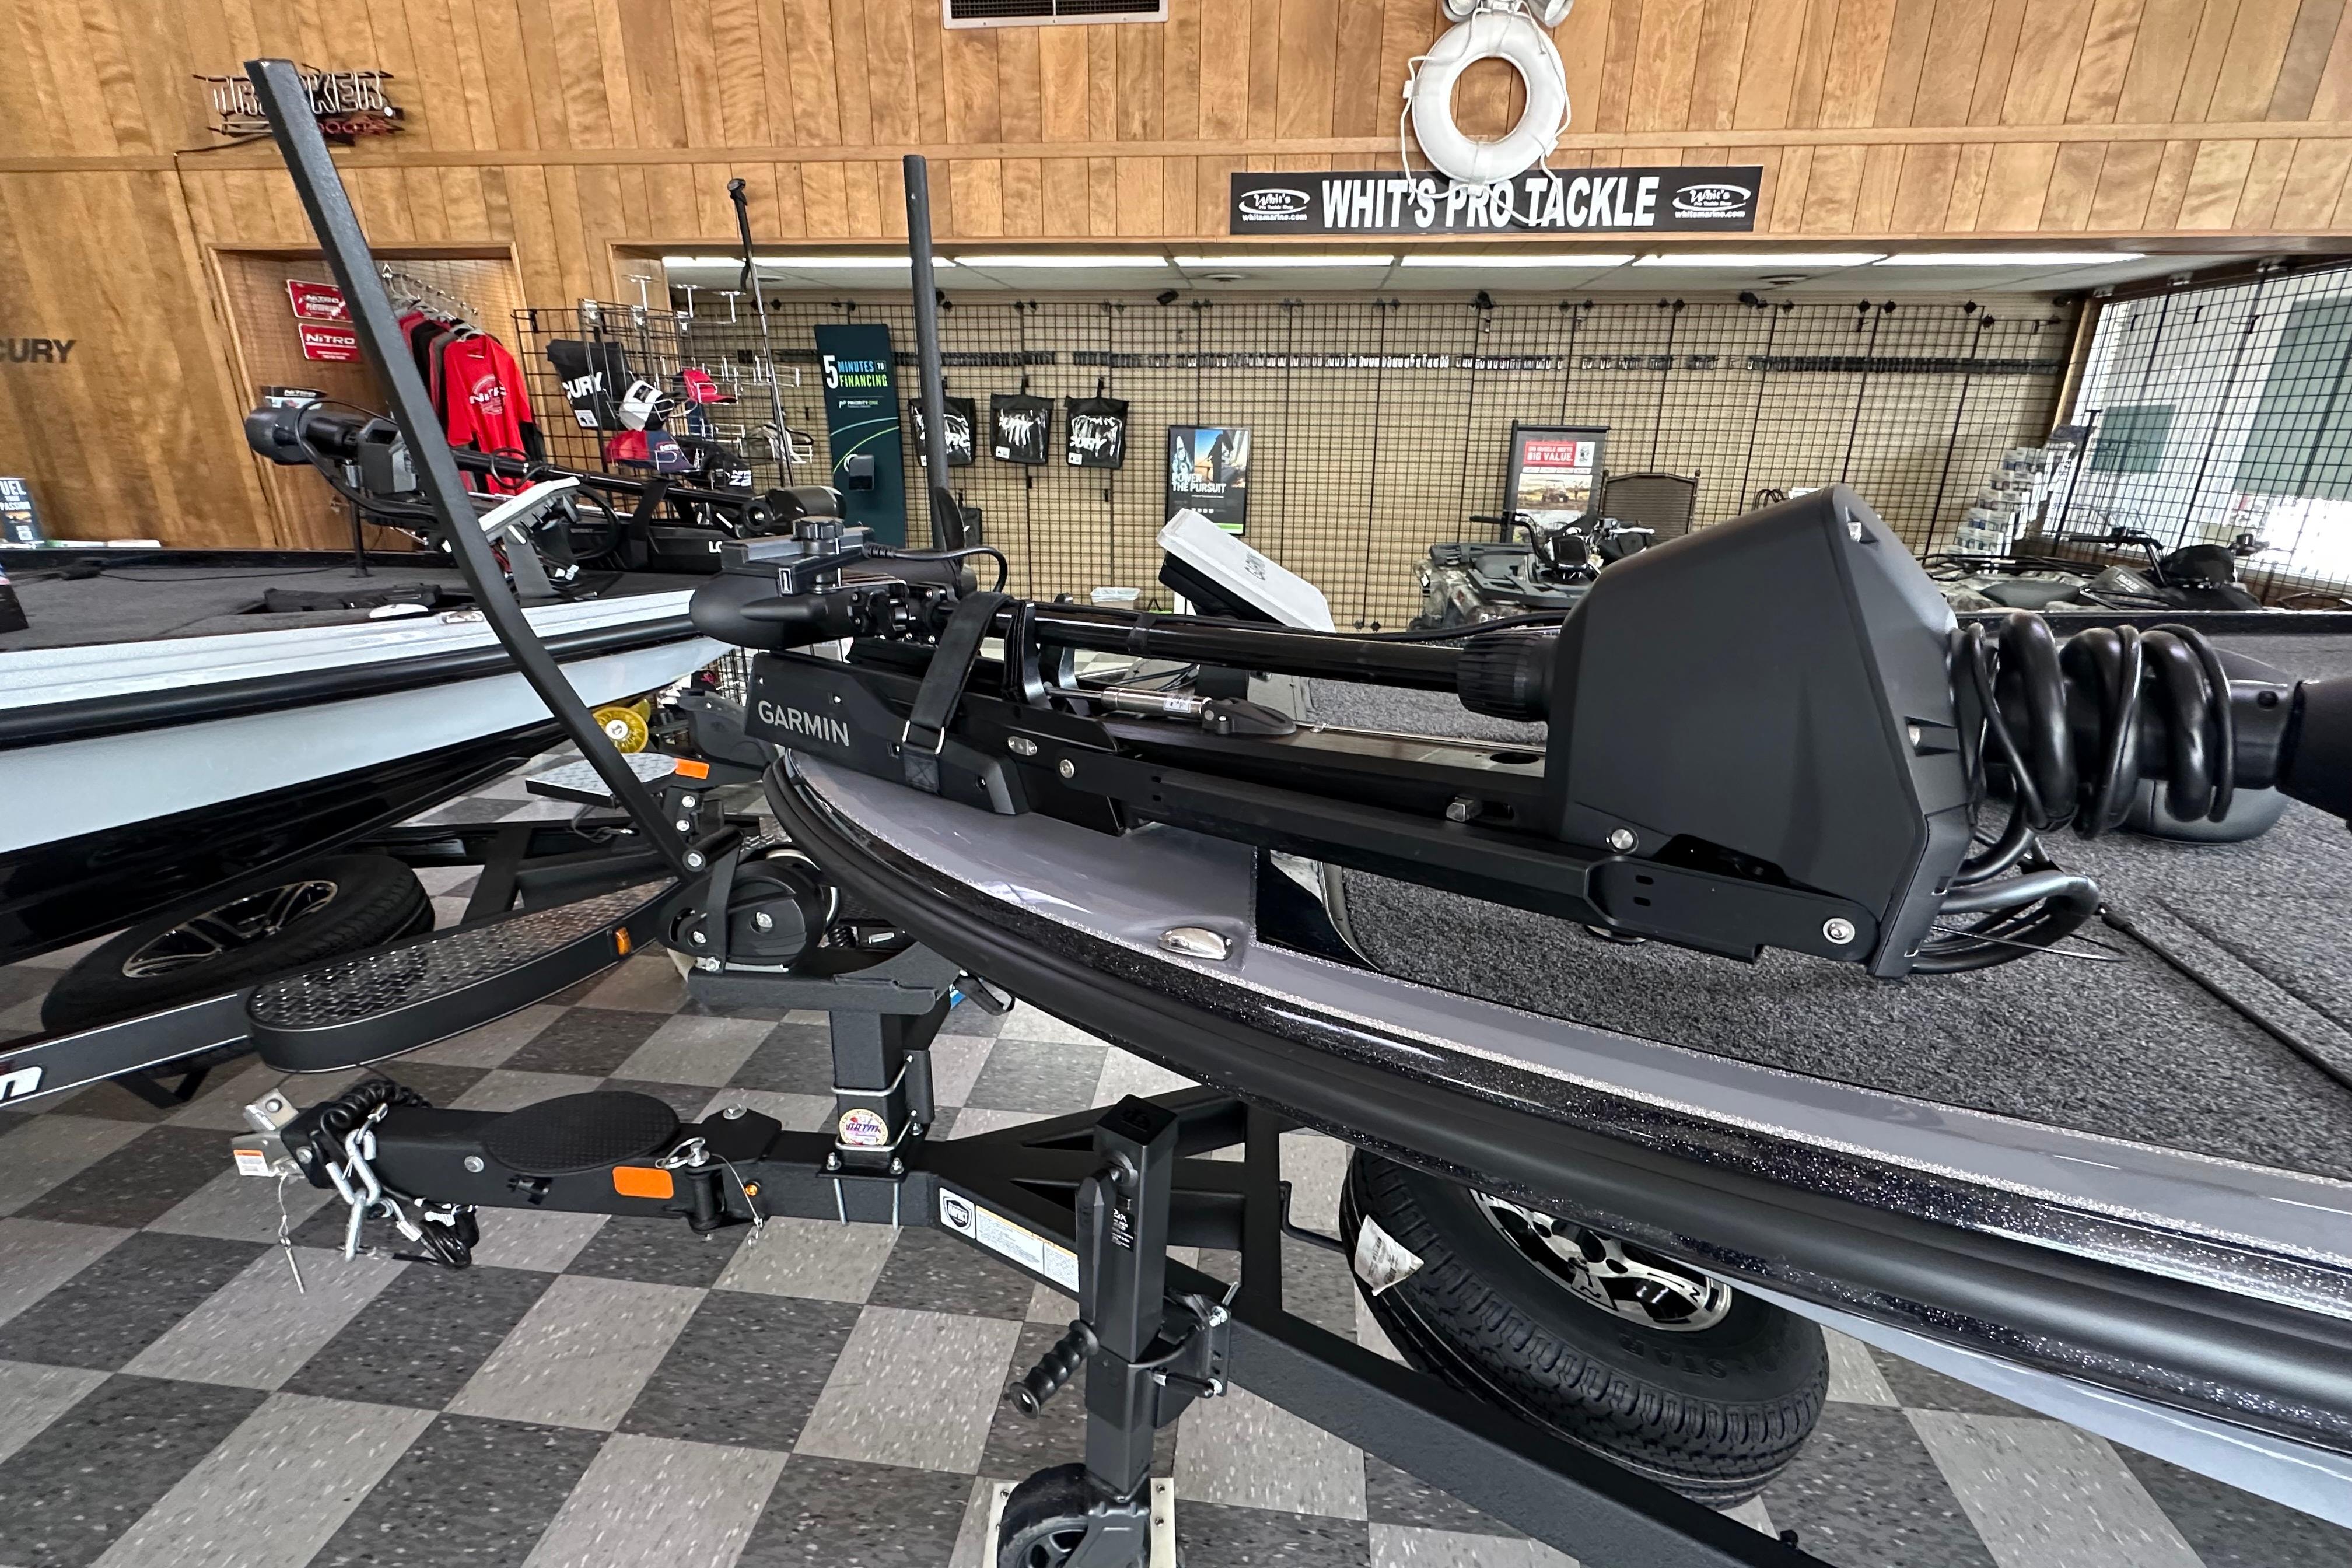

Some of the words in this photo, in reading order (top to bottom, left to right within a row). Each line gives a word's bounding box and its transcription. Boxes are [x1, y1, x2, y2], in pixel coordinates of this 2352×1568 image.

[206, 69, 384, 116] TRKER
[1254, 193, 1291, 207] Whit's
[1322, 178, 1436, 228] WHIT'S
[1445, 179, 1515, 228] PRO
[1525, 176, 1660, 228] TACKLE
[1689, 189, 1730, 203] Whit's
[0, 338, 77, 363] URY
[823, 355, 839, 389] 5
[838, 360, 874, 373] MINUTES
[877, 362, 884, 370] TO
[839, 373, 888, 387] FINANCING
[1171, 473, 1202, 482] POWER
[1172, 482, 1189, 491] THE
[1190, 483, 1226, 494] PURSUIT
[758, 700, 849, 747] GARMIN
